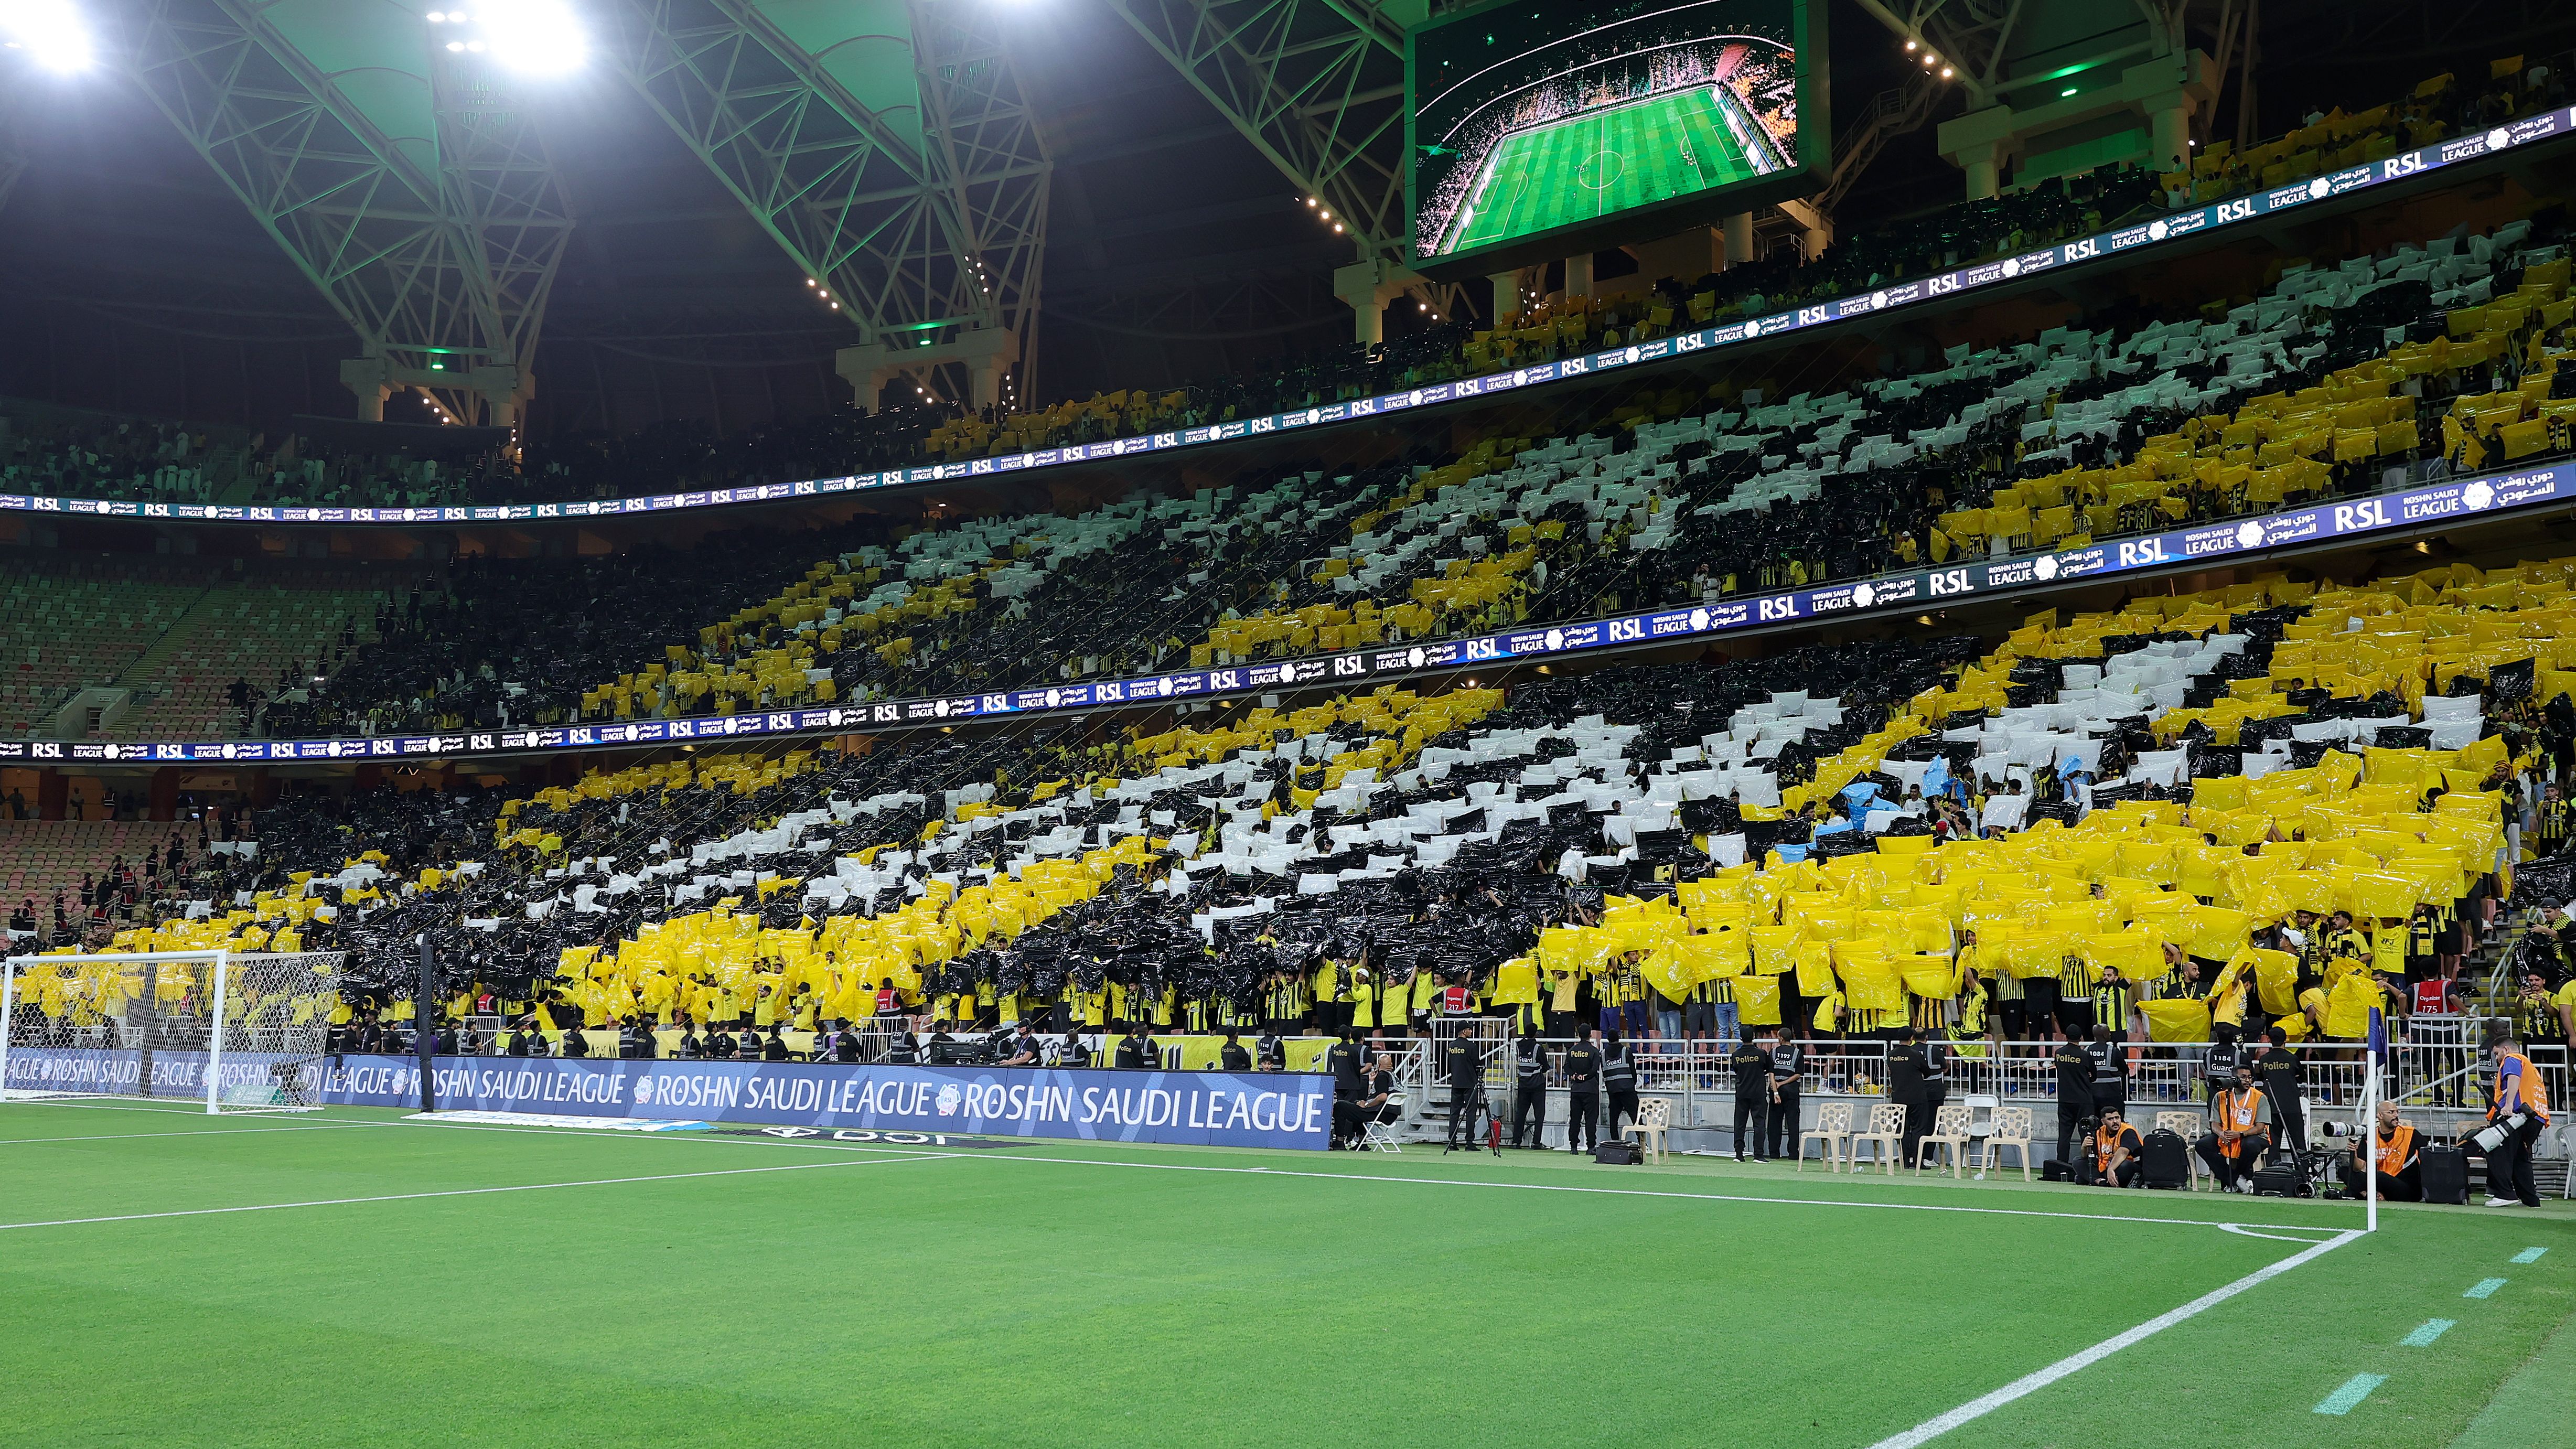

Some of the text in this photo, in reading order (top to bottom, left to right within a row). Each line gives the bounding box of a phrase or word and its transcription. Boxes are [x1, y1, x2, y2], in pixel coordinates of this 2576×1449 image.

[2511, 116, 2553, 133] دوري روشن
[2512, 123, 2554, 144] السعودي
[2442, 136, 2483, 152] ROSHN SAUDI
[2442, 142, 2484, 162] LEAGUE
[2385, 152, 2427, 178] RSL
[2332, 167, 2369, 183] دوري روشن
[2270, 185, 2306, 199] ROSHN SAUDI
[2332, 174, 2370, 194] السعودي
[2270, 191, 2307, 208] LEAGUE
[2218, 198, 2256, 223] RSL
[2169, 212, 2204, 226] دوري روشن
[2112, 227, 2146, 240] ROSHN SAUDI
[2170, 219, 2204, 236] السعودي
[2112, 233, 2146, 249] LEAGUE
[2021, 251, 2053, 263] دوري روشن
[2065, 239, 2100, 262] RSL
[2021, 257, 2053, 274] السعودي
[1929, 274, 1961, 295] RSL
[1969, 270, 2000, 285] LEAGUE
[1799, 305, 1829, 326] RSL
[1677, 333, 1705, 352] RSL
[1562, 358, 1588, 375] RSL
[1456, 379, 1482, 396] RSL
[1352, 400, 1376, 416] RSL
[1155, 433, 1177, 448] RSL
[972, 459, 994, 474] RSL
[795, 481, 816, 495] RSL
[2496, 473, 2553, 489] دوري روشن
[2403, 489, 2459, 505] ROSHN SAUDI
[2497, 482, 2554, 506] السعودي
[34, 498, 60, 510] RSL
[626, 498, 647, 511] RSL
[2404, 498, 2459, 519] LEAGUE
[251, 508, 275, 520] RSL
[445, 508, 467, 519] RSL
[2266, 514, 2315, 529] دوري روشن
[2335, 500, 2391, 532] RSL
[2186, 528, 2234, 542] ROSHN SAUDI
[2267, 523, 2316, 544] السعودي
[2120, 538, 2169, 566] RSL
[2186, 536, 2234, 555] LEAGUE
[2060, 550, 2103, 563] دوري روشن
[1989, 561, 2031, 573] ROSHN SAUDI
[2060, 558, 2103, 577] السعودي
[1876, 579, 1915, 591] دوري روشن
[1930, 570, 1973, 595] RSL
[1989, 569, 2032, 586] LEAGUE
[1813, 596, 1851, 611] LEAGUE
[1876, 587, 1915, 605] السعودي
[1711, 605, 1746, 616] دوري روشن
[1760, 596, 1799, 620] RSL
[1653, 620, 1688, 634] LEAGUE
[1711, 613, 1746, 628] السعودي
[1565, 627, 1597, 636] دوري روشن
[1609, 618, 1645, 641] RSL
[1467, 638, 1500, 659] RSL
[1511, 640, 1543, 653] LEAGUE
[1565, 634, 1597, 648] السعودي
[1335, 656, 1366, 675] RSL
[1211, 671, 1240, 690] RSL
[1097, 683, 1124, 701] RSL
[983, 695, 1010, 712] RSL
[875, 705, 900, 721] RSL
[670, 722, 694, 737] RSL
[769, 714, 794, 729] RSL
[471, 735, 494, 749] RSL
[570, 728, 594, 744] RSL
[33, 743, 63, 757] RSL
[157, 745, 185, 758] RSL
[272, 743, 297, 757] RSL
[373, 740, 396, 754] RSL
[1606, 1058, 1622, 1066] Guard
[1735, 1055, 1759, 1064] Police
[2056, 1054, 2081, 1063] Police
[2263, 1061, 2290, 1071] Police
[52, 1058, 198, 1087] ROSHN SAUDI EAGUE
[408, 1069, 626, 1104] RSHN SAUDI LEAGUE
[655, 1075, 932, 1116] ROSHN SAUDI LEAGUE
[963, 1083, 1324, 1133] ROSHN SAUDI LEAGUE
